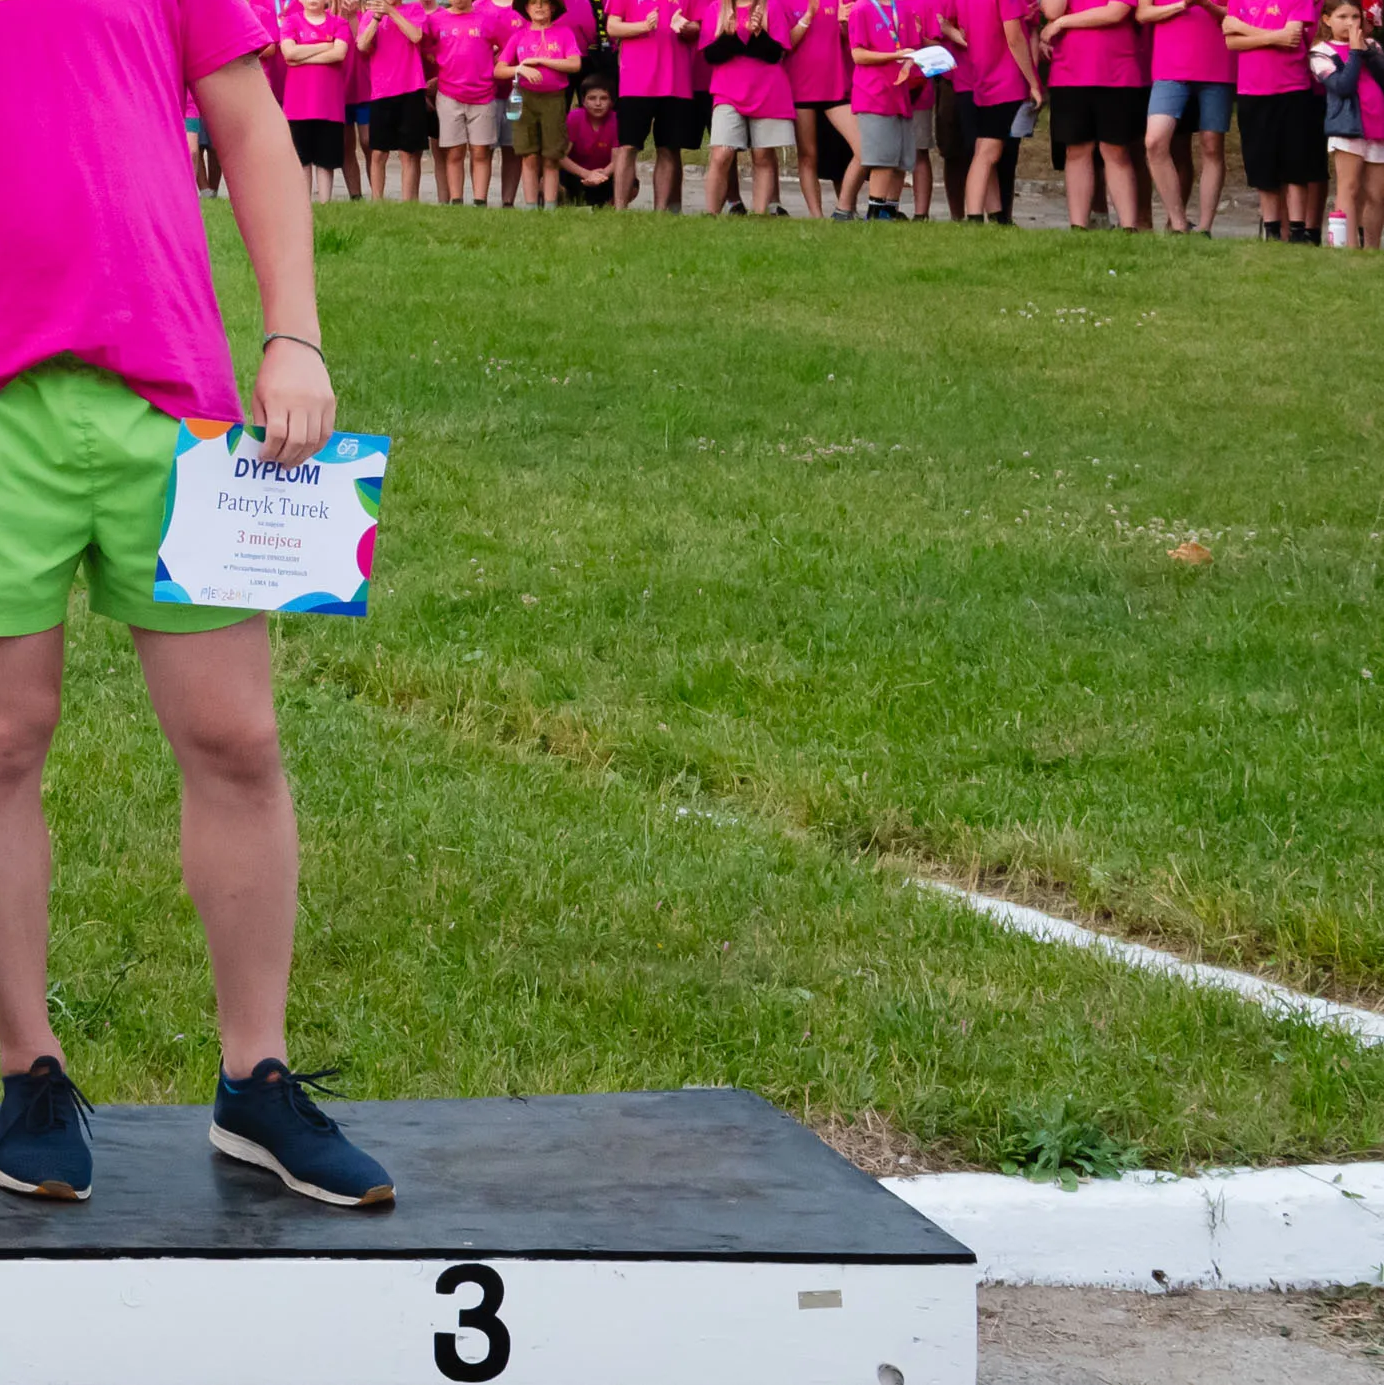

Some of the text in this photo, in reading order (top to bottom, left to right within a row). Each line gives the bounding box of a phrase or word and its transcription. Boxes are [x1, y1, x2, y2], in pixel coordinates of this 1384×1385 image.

[234, 457, 321, 485] DYPLOM
[217, 491, 329, 520] Patryk Turek
[236, 530, 302, 550] 3 miejsca
[434, 1263, 511, 1383] 3
